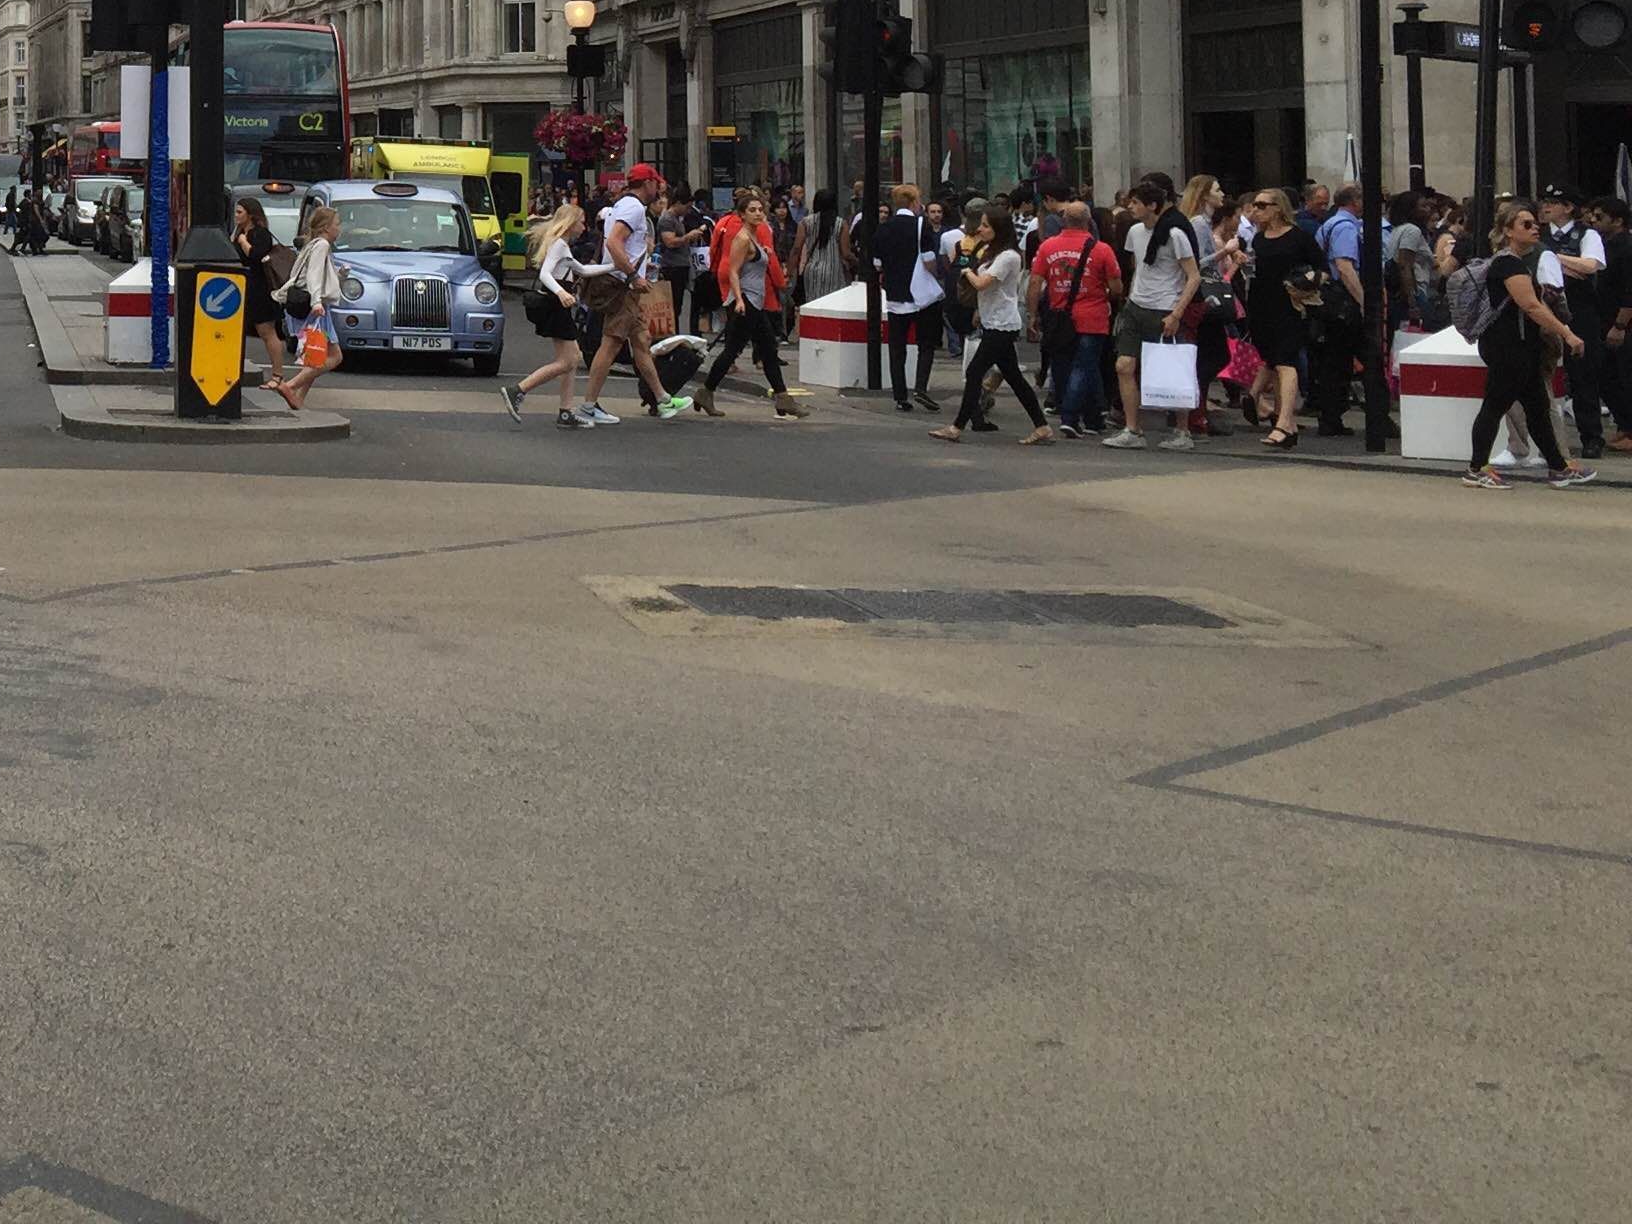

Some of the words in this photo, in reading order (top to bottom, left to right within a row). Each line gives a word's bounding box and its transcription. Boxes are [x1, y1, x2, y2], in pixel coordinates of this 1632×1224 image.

[224, 115, 269, 127] Victoria
[299, 113, 324, 131] C2
[402, 337, 418, 347] N17
